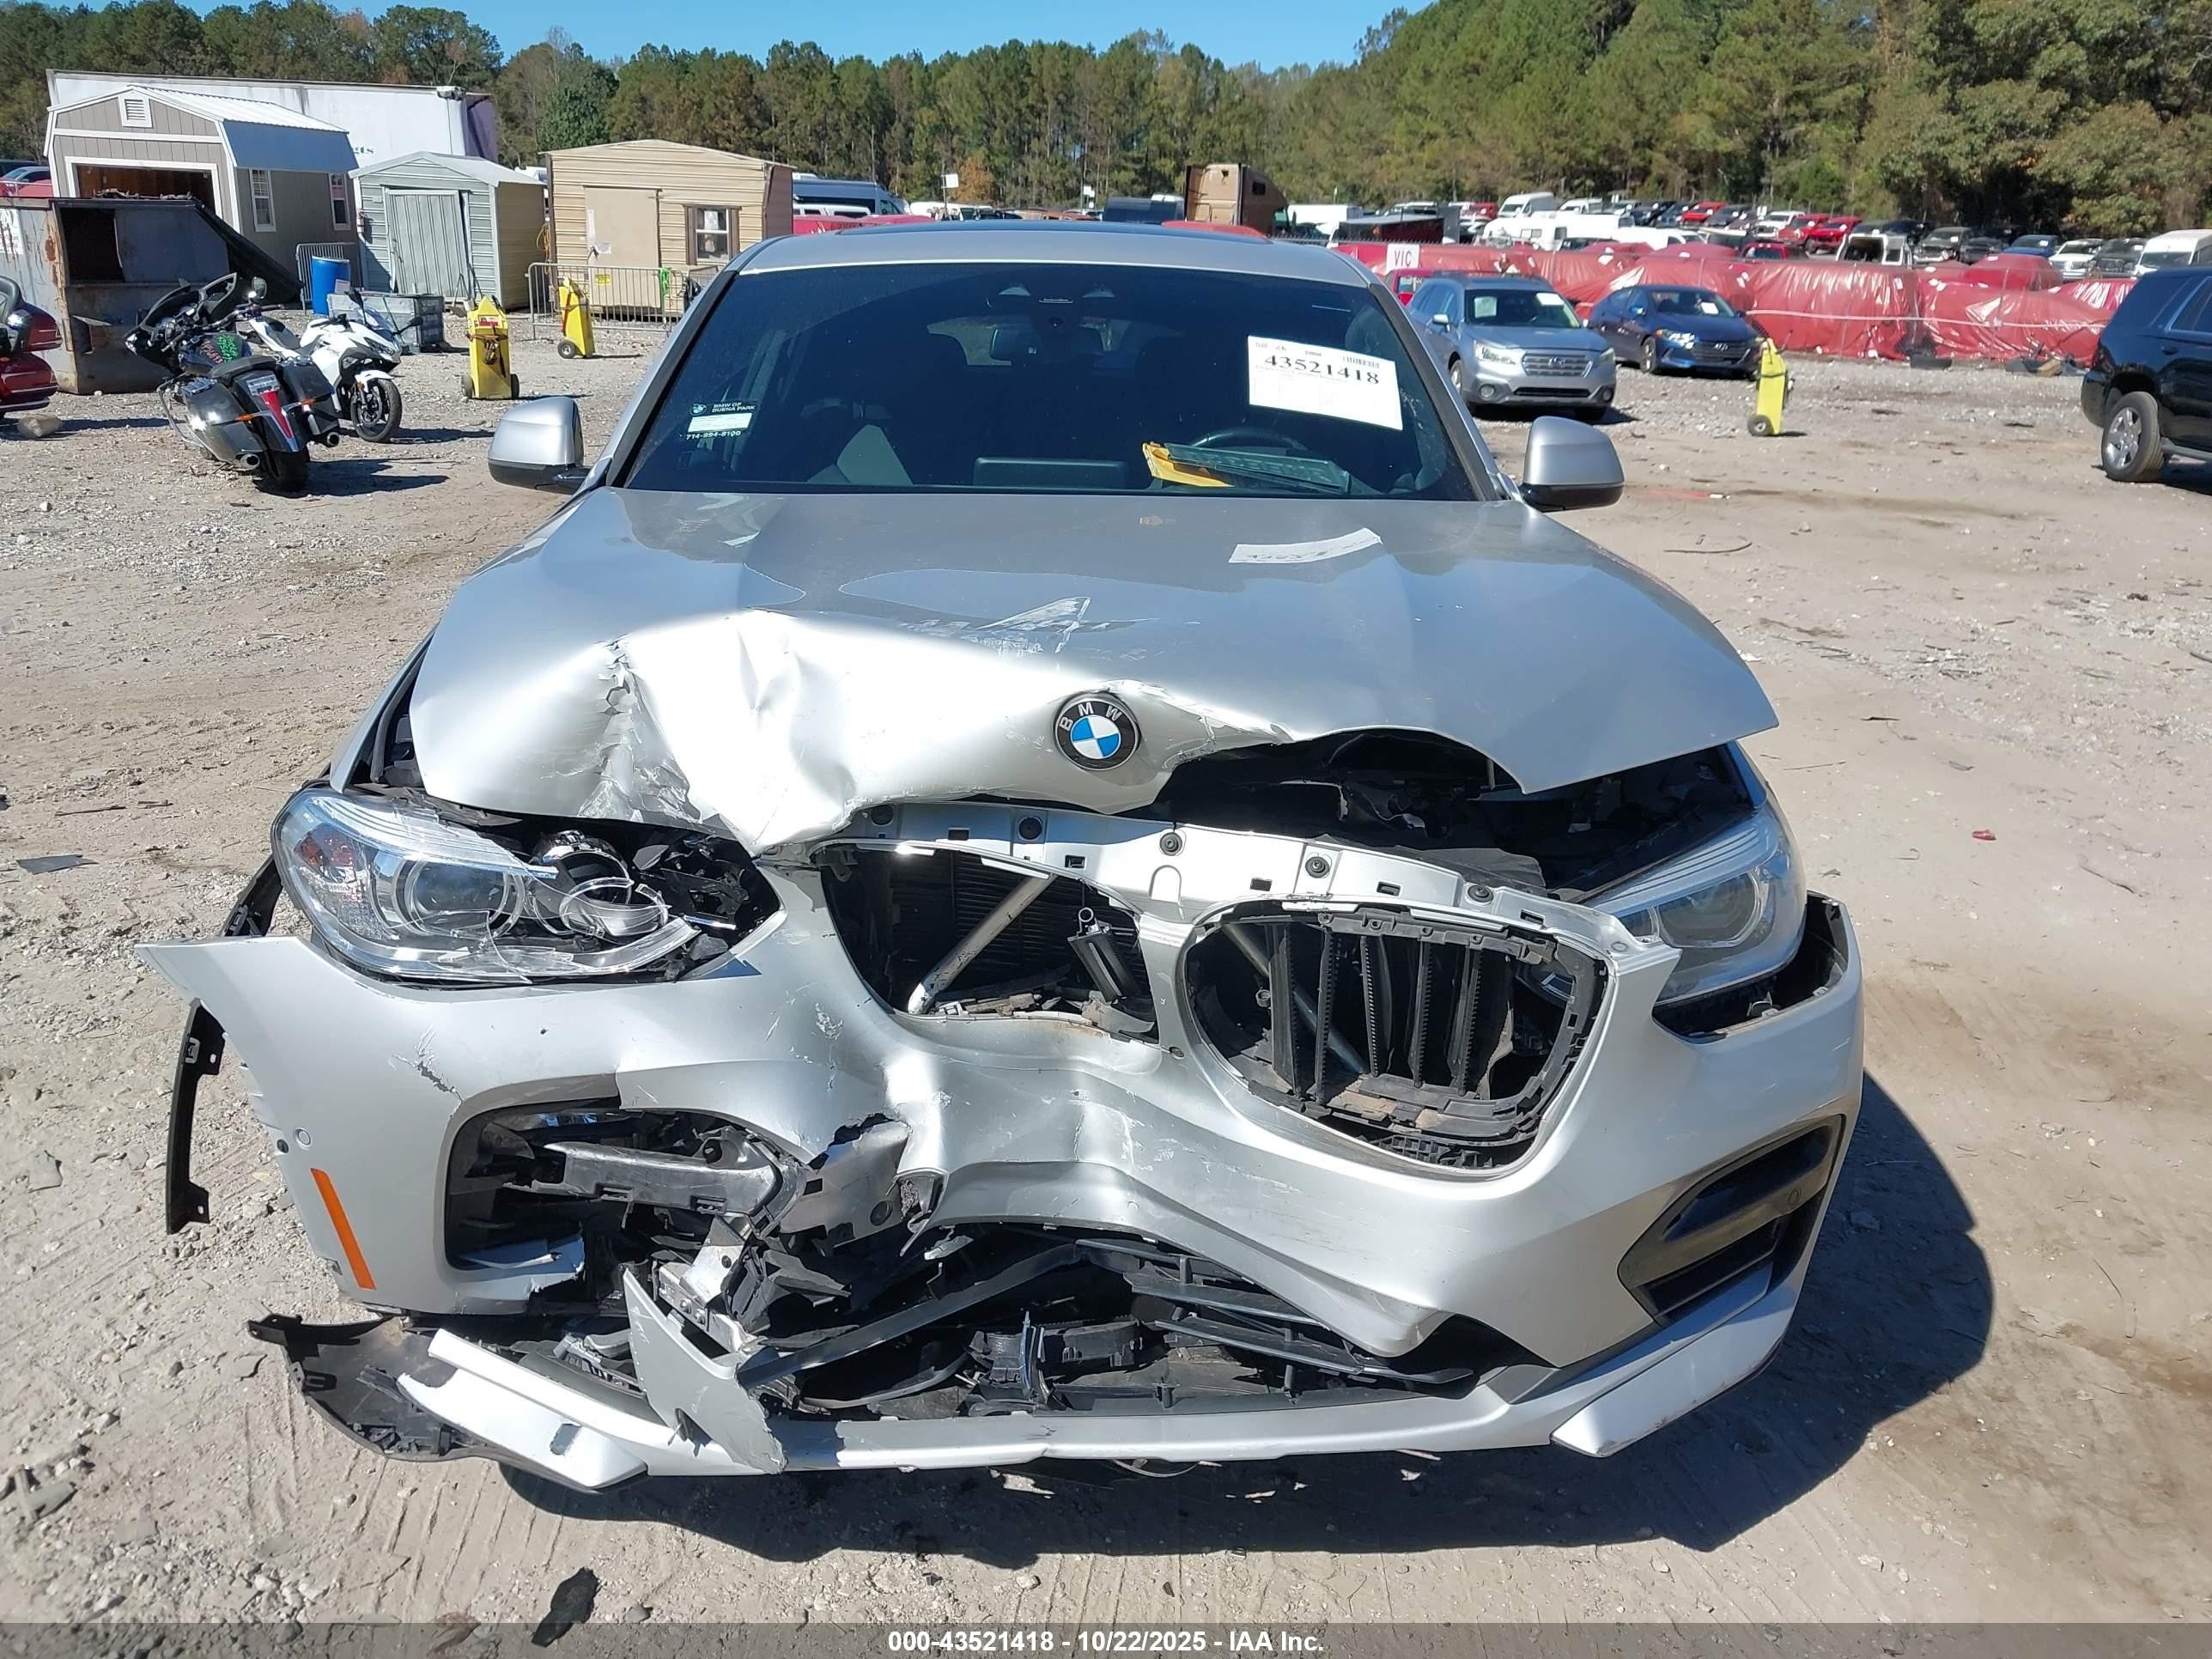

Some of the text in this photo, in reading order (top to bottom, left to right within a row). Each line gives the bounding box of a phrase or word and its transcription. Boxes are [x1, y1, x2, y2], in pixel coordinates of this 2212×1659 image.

[1395, 250, 1412, 268] VIC
[1264, 355, 1379, 384] 43521418
[1059, 702, 1123, 732] BMW
